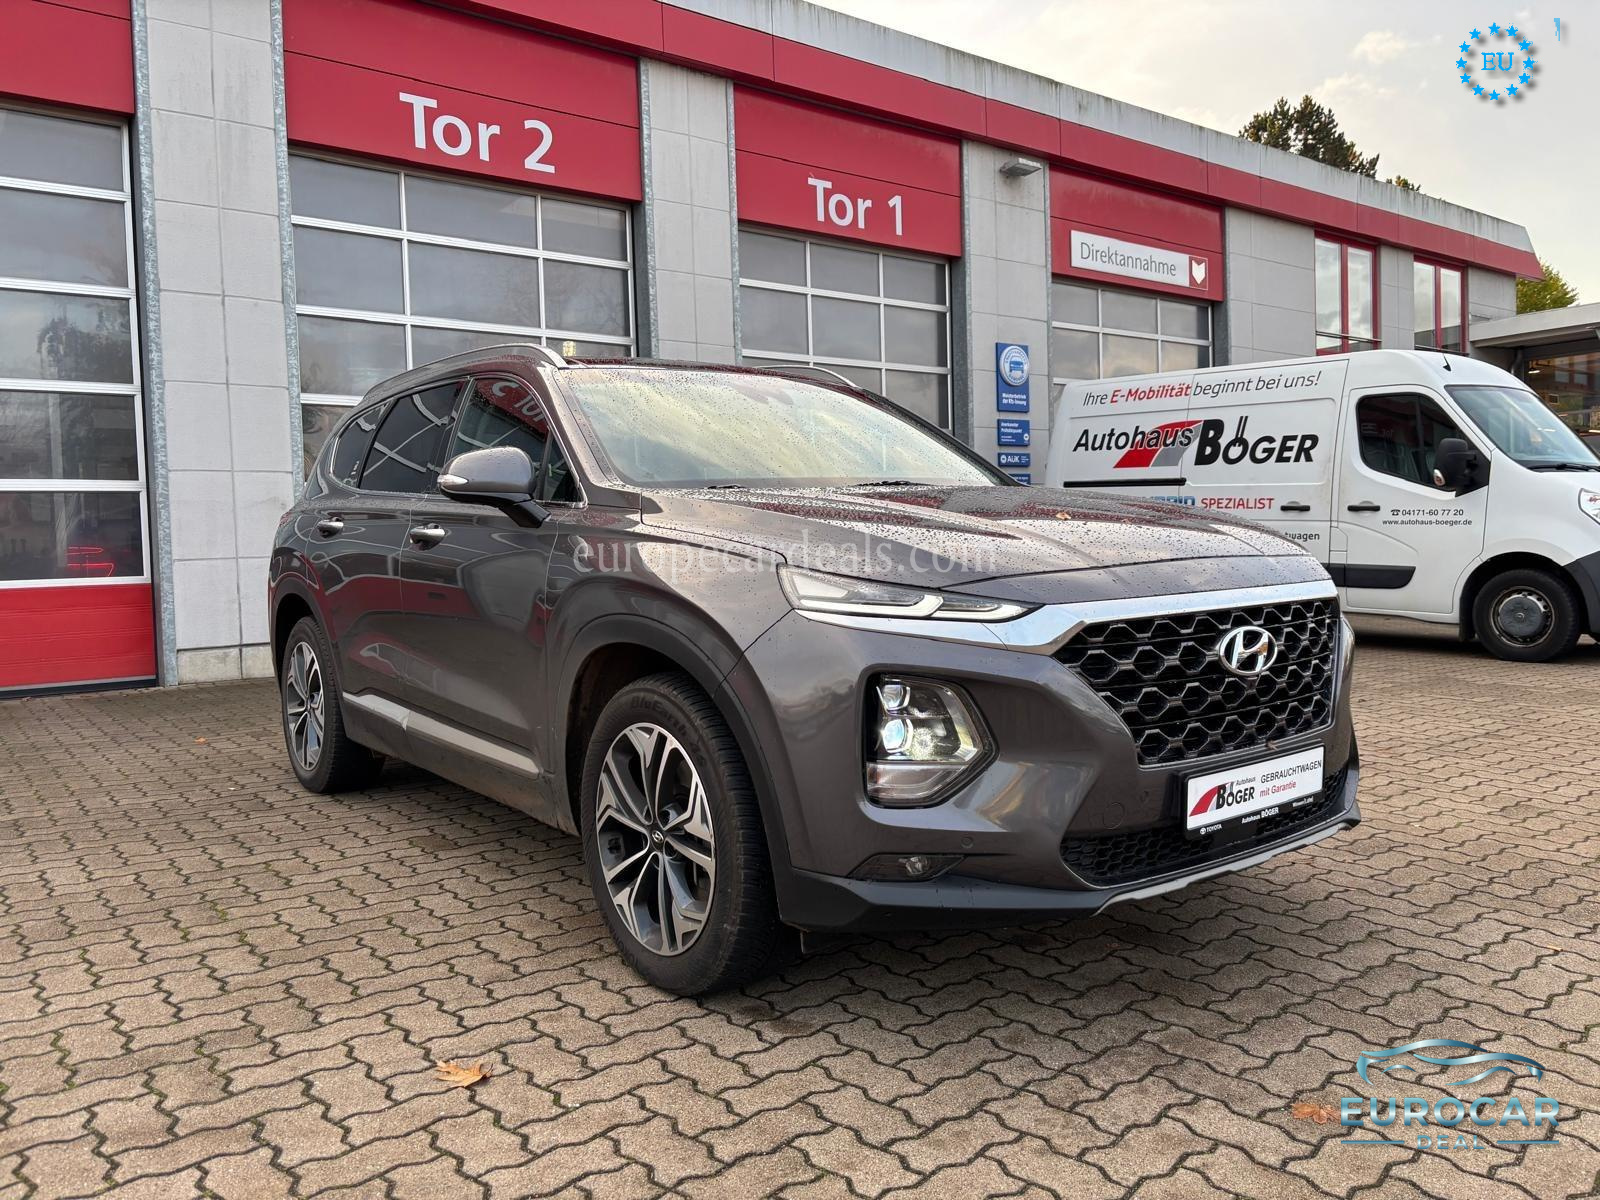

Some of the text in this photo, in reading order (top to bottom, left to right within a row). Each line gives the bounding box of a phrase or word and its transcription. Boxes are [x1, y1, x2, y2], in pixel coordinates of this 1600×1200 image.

[399, 92, 555, 174] Tor 2
[808, 177, 903, 236] Tor 1
[1080, 242, 1177, 276] Direktannahme
[1083, 371, 1322, 406] Ihre E-Mobilität beginnt bei uns!
[1072, 425, 1194, 452] Autohaus
[1201, 497, 1275, 510] SPEZIALIST
[1235, 776, 1256, 786] Autohaus
[1260, 760, 1322, 784] GEBRAUCHTWAGEN
[1260, 780, 1297, 797] mit Garantie
[1206, 824, 1222, 833] TOYOTA
